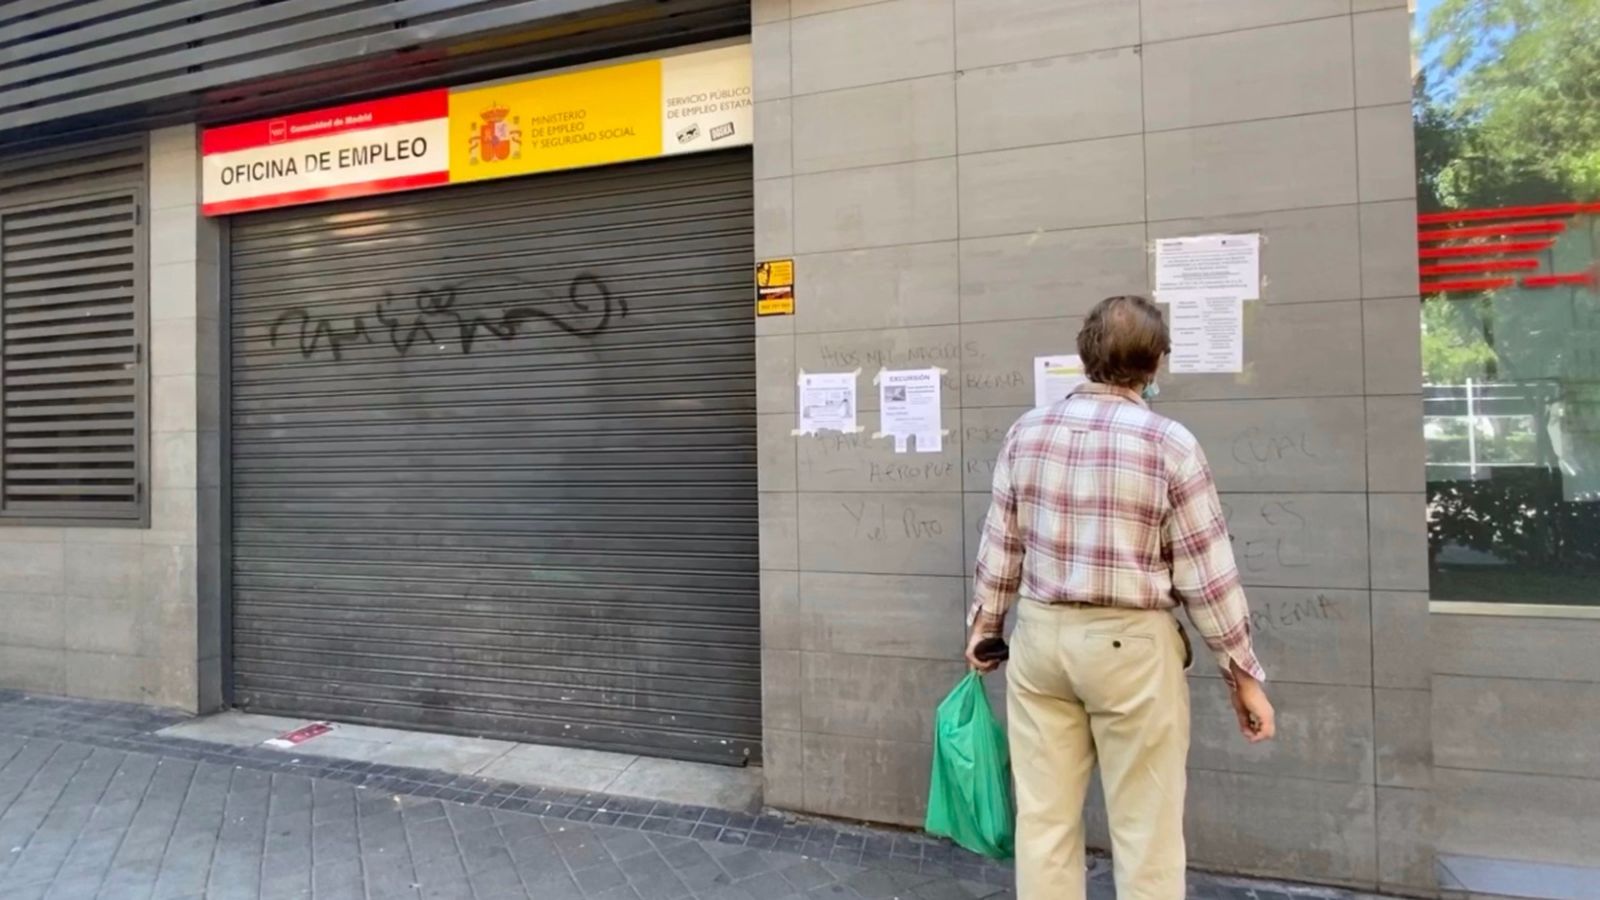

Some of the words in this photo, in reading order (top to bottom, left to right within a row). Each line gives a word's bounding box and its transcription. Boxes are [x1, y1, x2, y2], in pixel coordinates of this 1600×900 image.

[666, 93, 708, 107] SERVICIO
[709, 86, 751, 100] PÚBLICO
[531, 109, 587, 126] MINISTERIO
[667, 109, 680, 119] DE
[681, 104, 718, 117] EMPLEO
[719, 98, 752, 111] ESTATA
[290, 119, 333, 134] Comunidad
[333, 118, 344, 127] de
[345, 112, 373, 125] Madrid
[531, 127, 545, 138] DE
[547, 121, 585, 136] EMPLEO
[531, 140, 539, 149] Y
[541, 131, 597, 149] SEGURIDAD
[599, 126, 637, 140] SOCIAL
[221, 157, 298, 186] OFICINA
[304, 151, 331, 173] DE
[338, 136, 428, 169] EMPLEO
[889, 373, 930, 383] EXCURSIÓN
[869, 455, 999, 483] AEROPUERT
